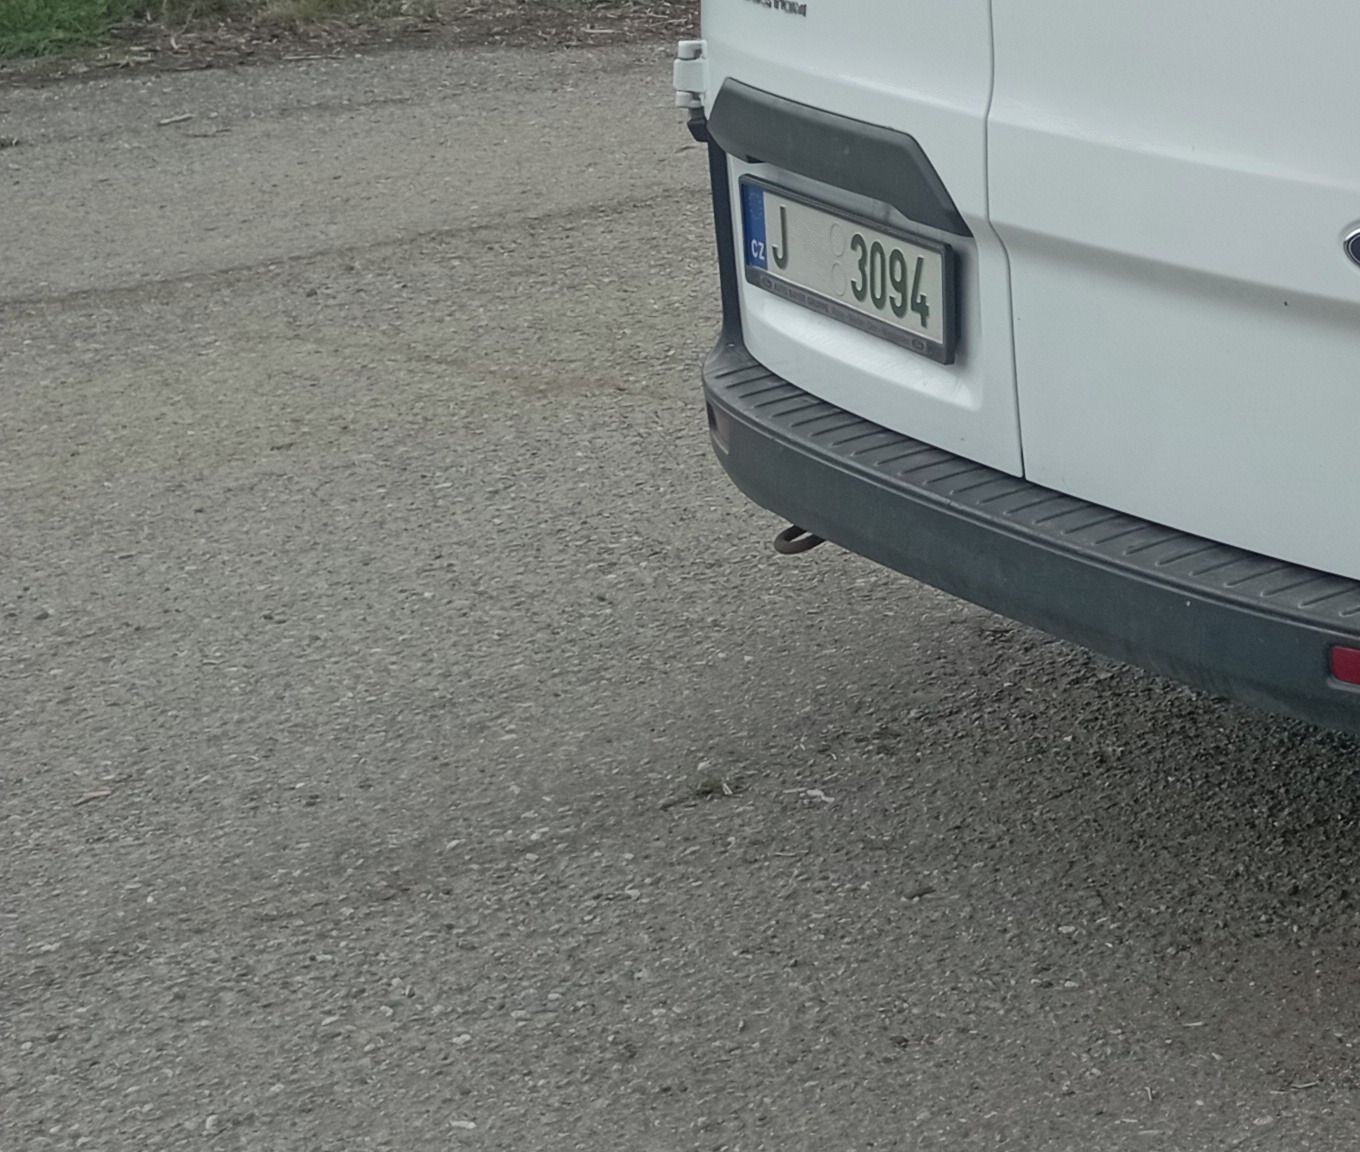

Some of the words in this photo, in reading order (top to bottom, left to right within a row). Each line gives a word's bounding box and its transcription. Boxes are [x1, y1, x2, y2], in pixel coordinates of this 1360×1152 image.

[751, 239, 765, 260] CZ
[772, 206, 788, 269] J
[851, 233, 929, 328] 3094
